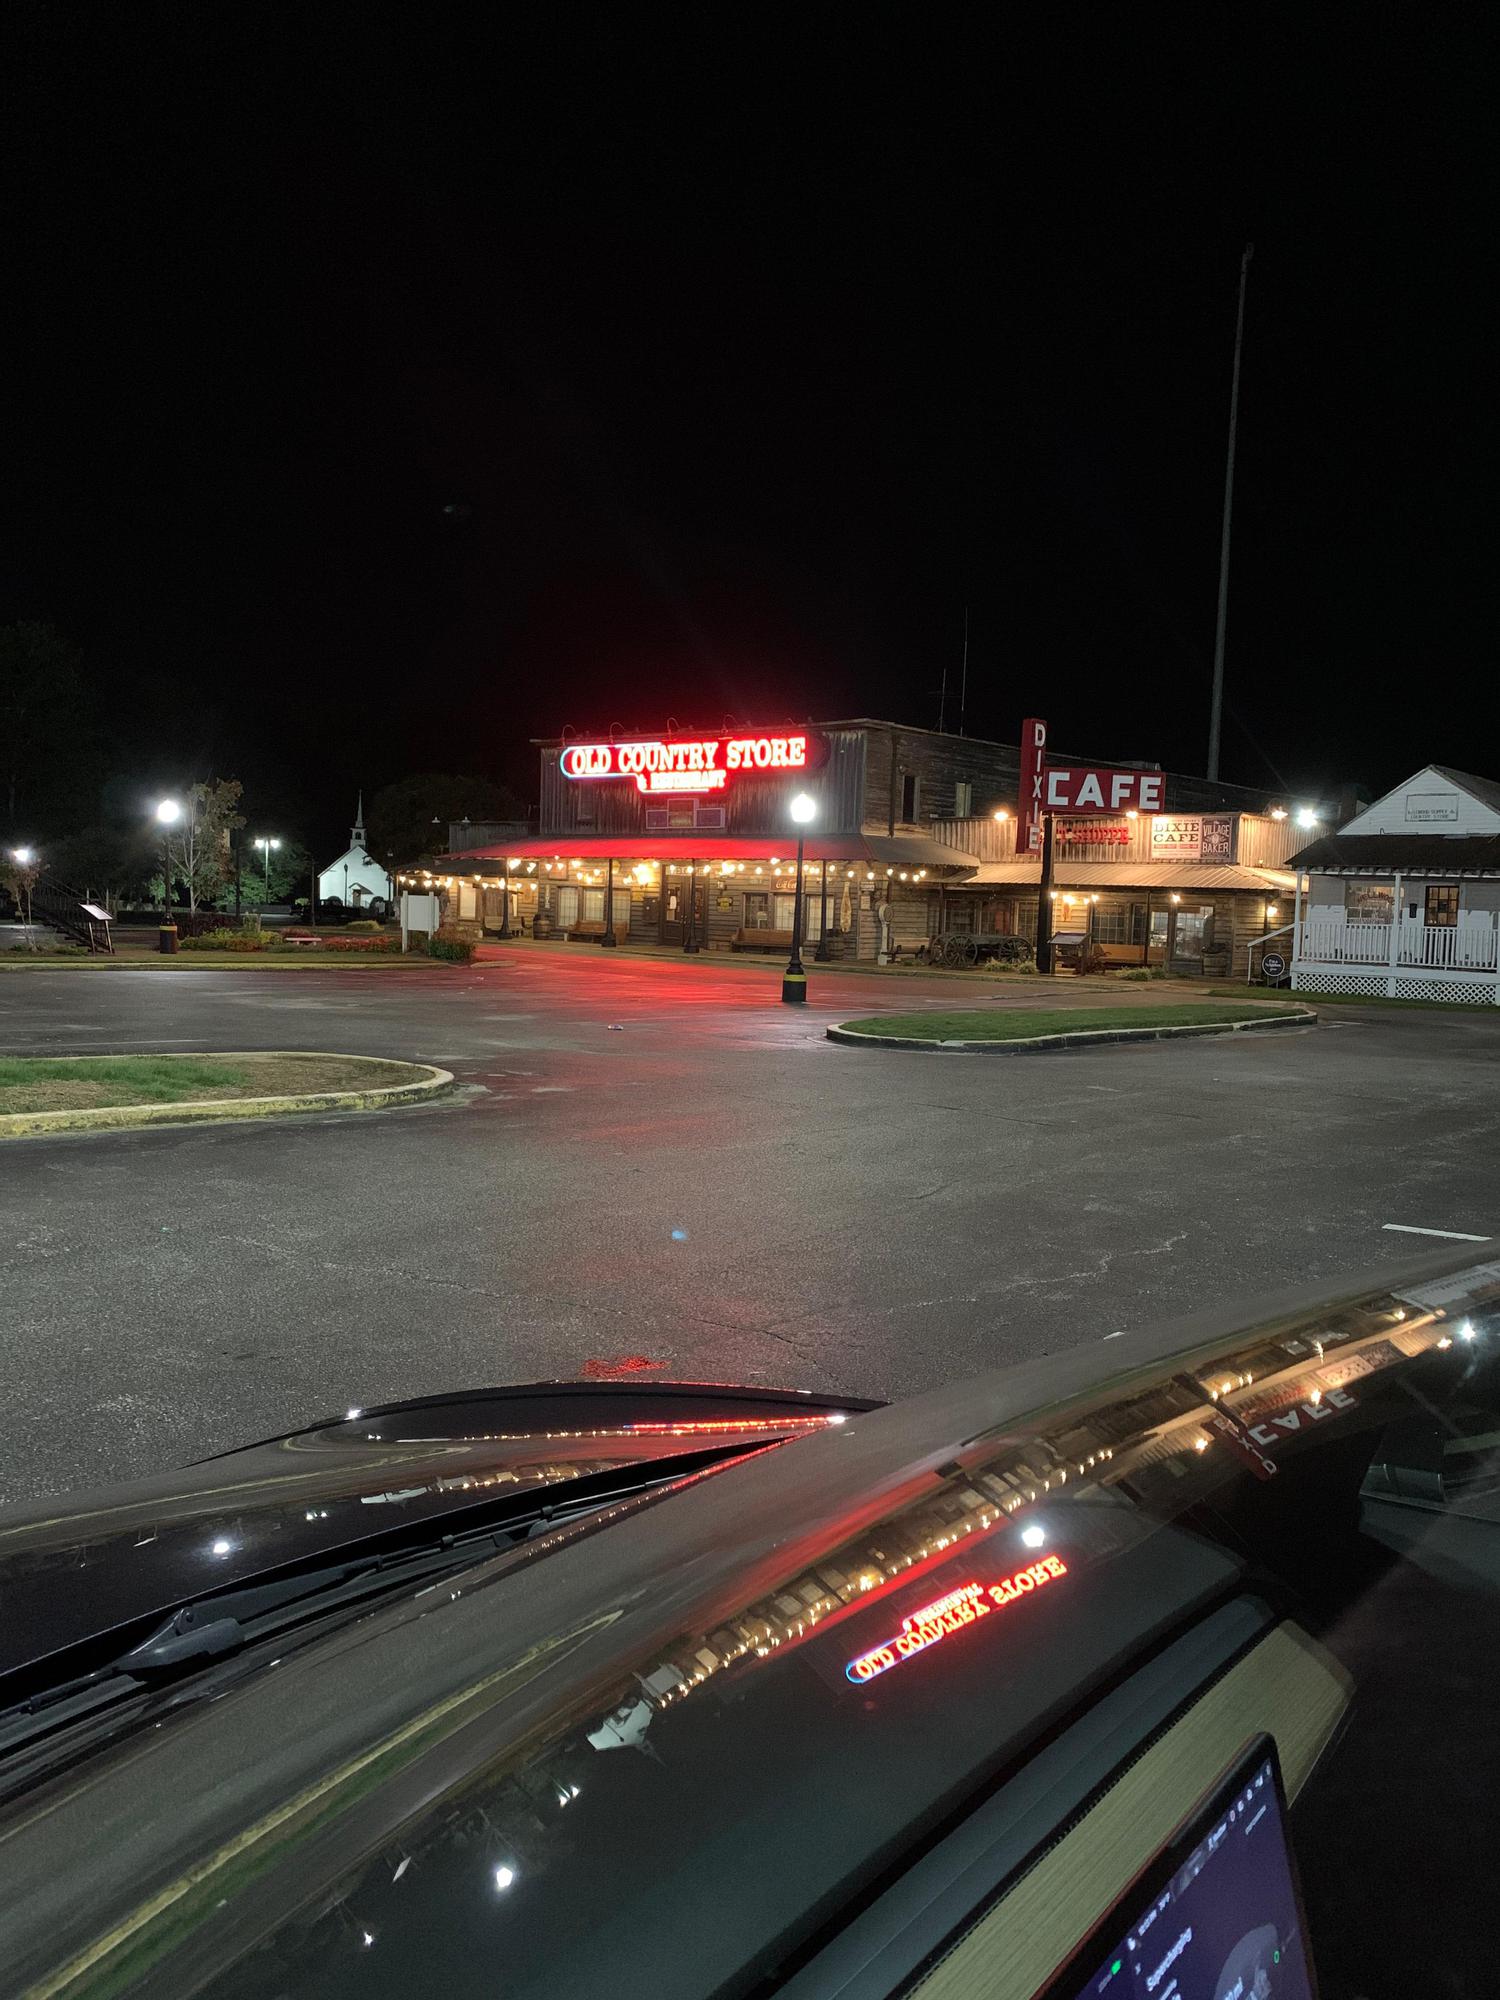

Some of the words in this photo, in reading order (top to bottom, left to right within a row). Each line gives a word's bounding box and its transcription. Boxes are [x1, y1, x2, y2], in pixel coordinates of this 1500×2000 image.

[572, 747, 611, 774] OLD
[618, 743, 718, 772] COUNTRY
[726, 737, 806, 769] STORE
[1029, 723, 1046, 849] DIXIE
[1047, 772, 1162, 810] CAFE
[1155, 823, 1199, 832] DIXIE
[1203, 822, 1230, 837] VILLAGE
[1154, 834, 1199, 842] CAFE
[1202, 842, 1229, 853] BAKER
